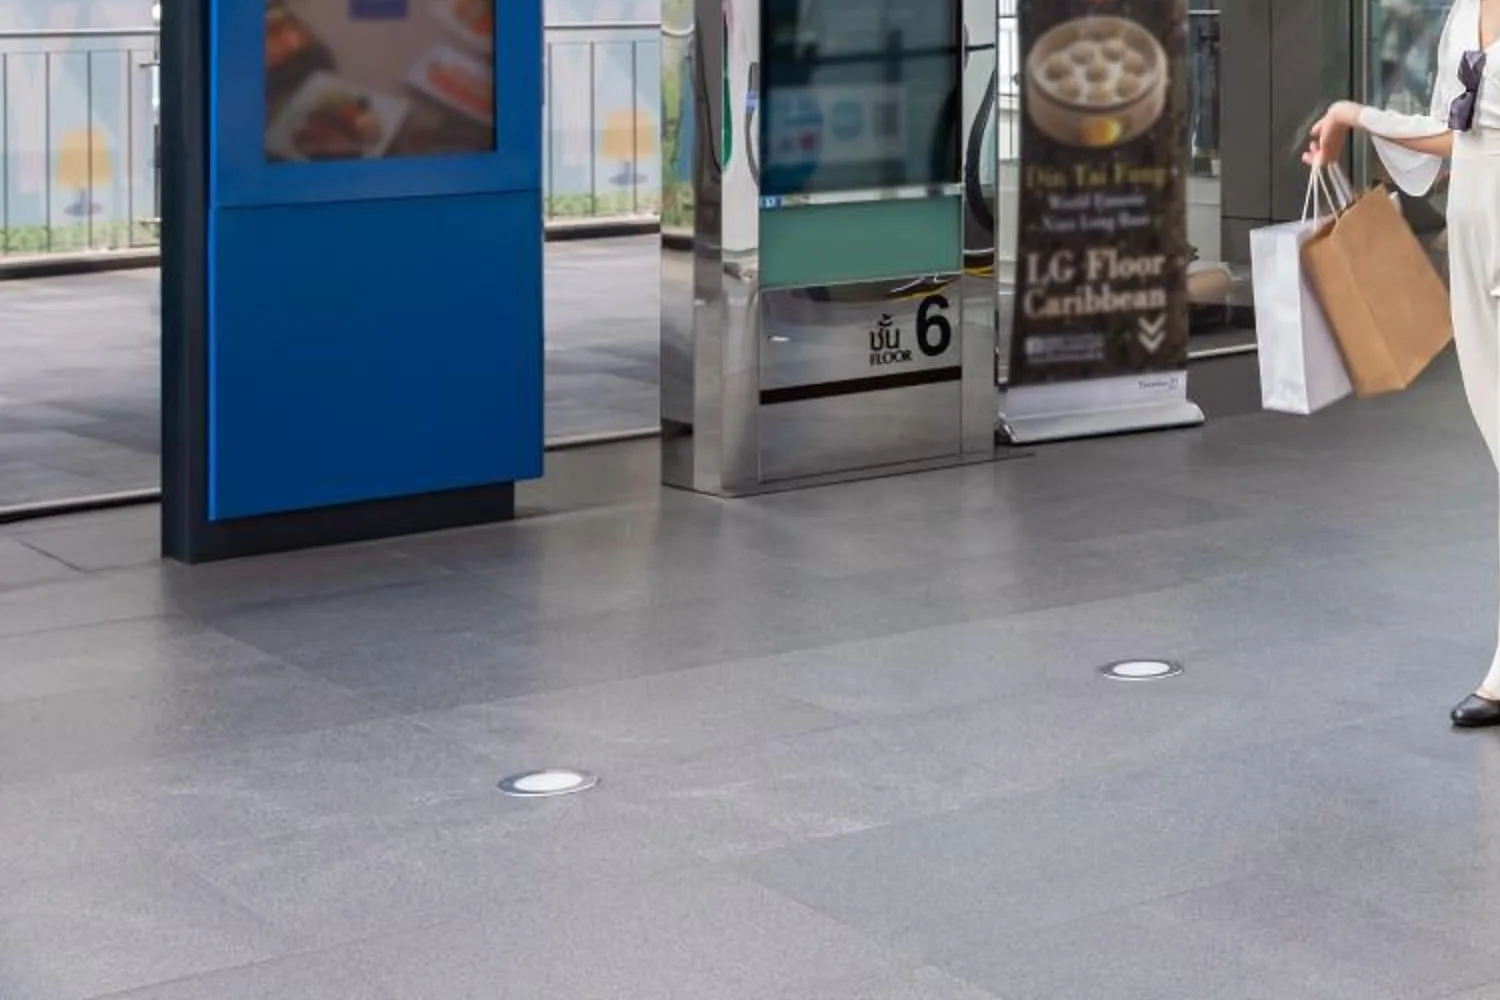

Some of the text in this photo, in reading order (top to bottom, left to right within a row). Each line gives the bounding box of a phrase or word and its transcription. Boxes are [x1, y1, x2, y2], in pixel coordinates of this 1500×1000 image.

[1026, 247, 1166, 284] LG Floor
[1023, 283, 1167, 320] Caribbean
[869, 313, 900, 351] ชั้น
[916, 294, 951, 356] 6
[869, 349, 913, 366] FLOOR
